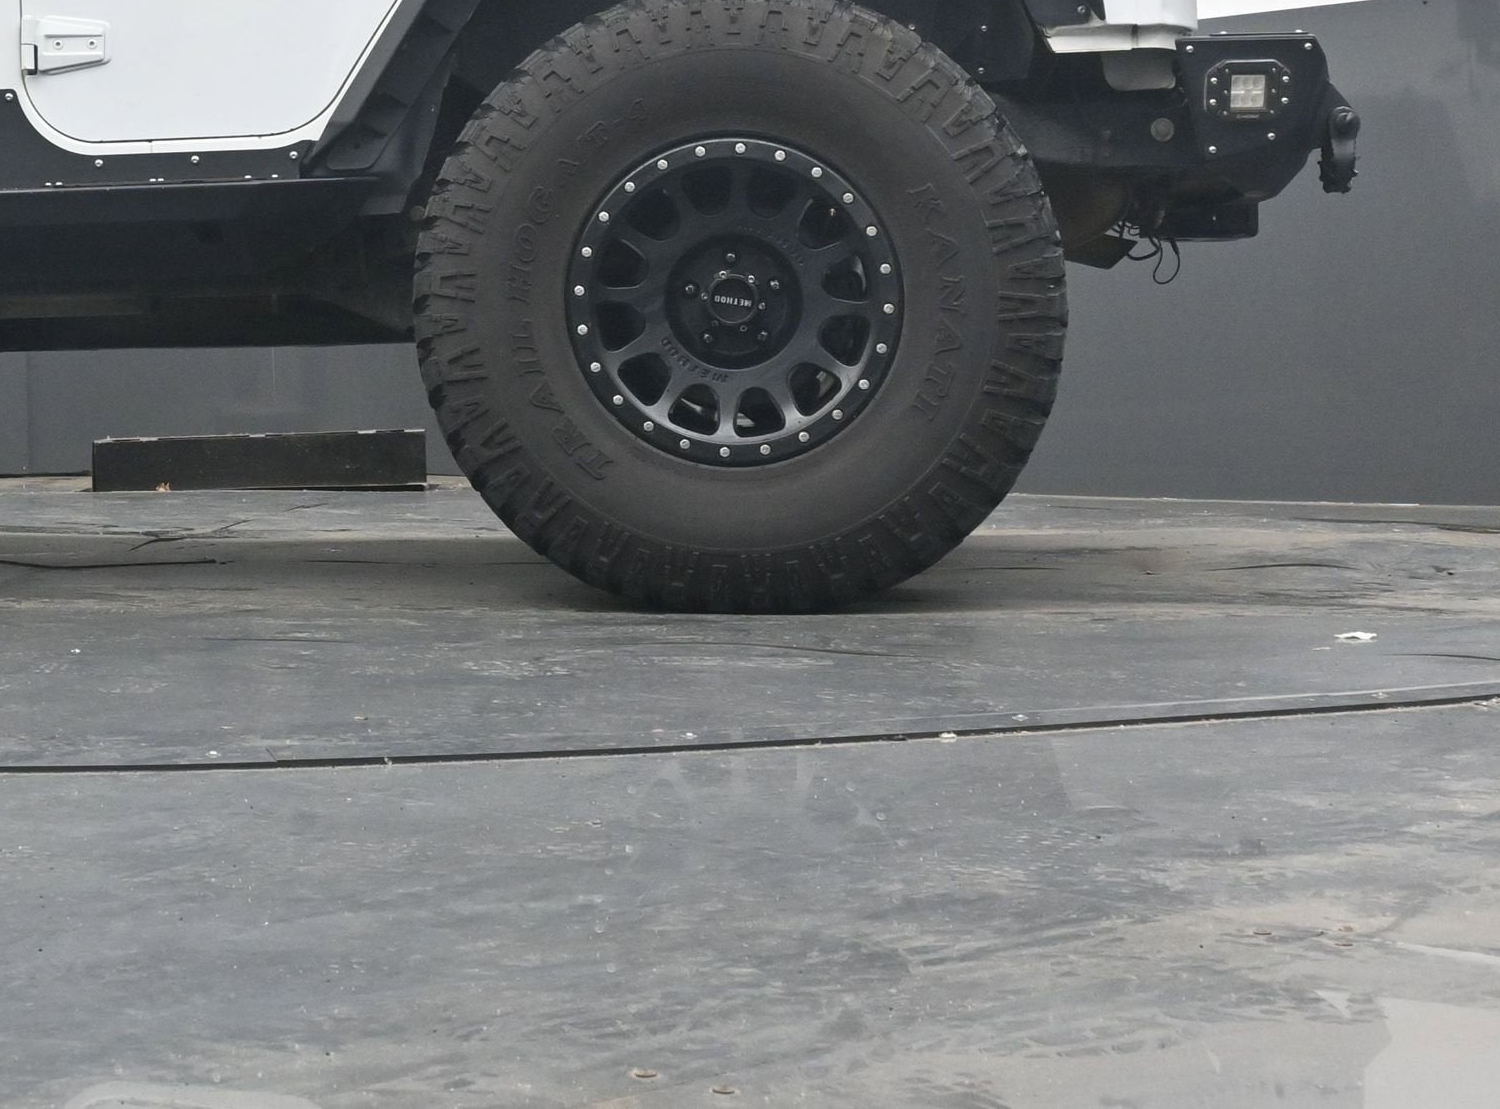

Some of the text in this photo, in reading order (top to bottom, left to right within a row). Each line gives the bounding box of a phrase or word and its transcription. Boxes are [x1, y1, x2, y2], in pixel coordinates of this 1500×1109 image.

[507, 185, 554, 305] HOG
[713, 295, 752, 307] METHOD
[905, 182, 967, 422] KANATI
[512, 319, 614, 480] TRAIL
